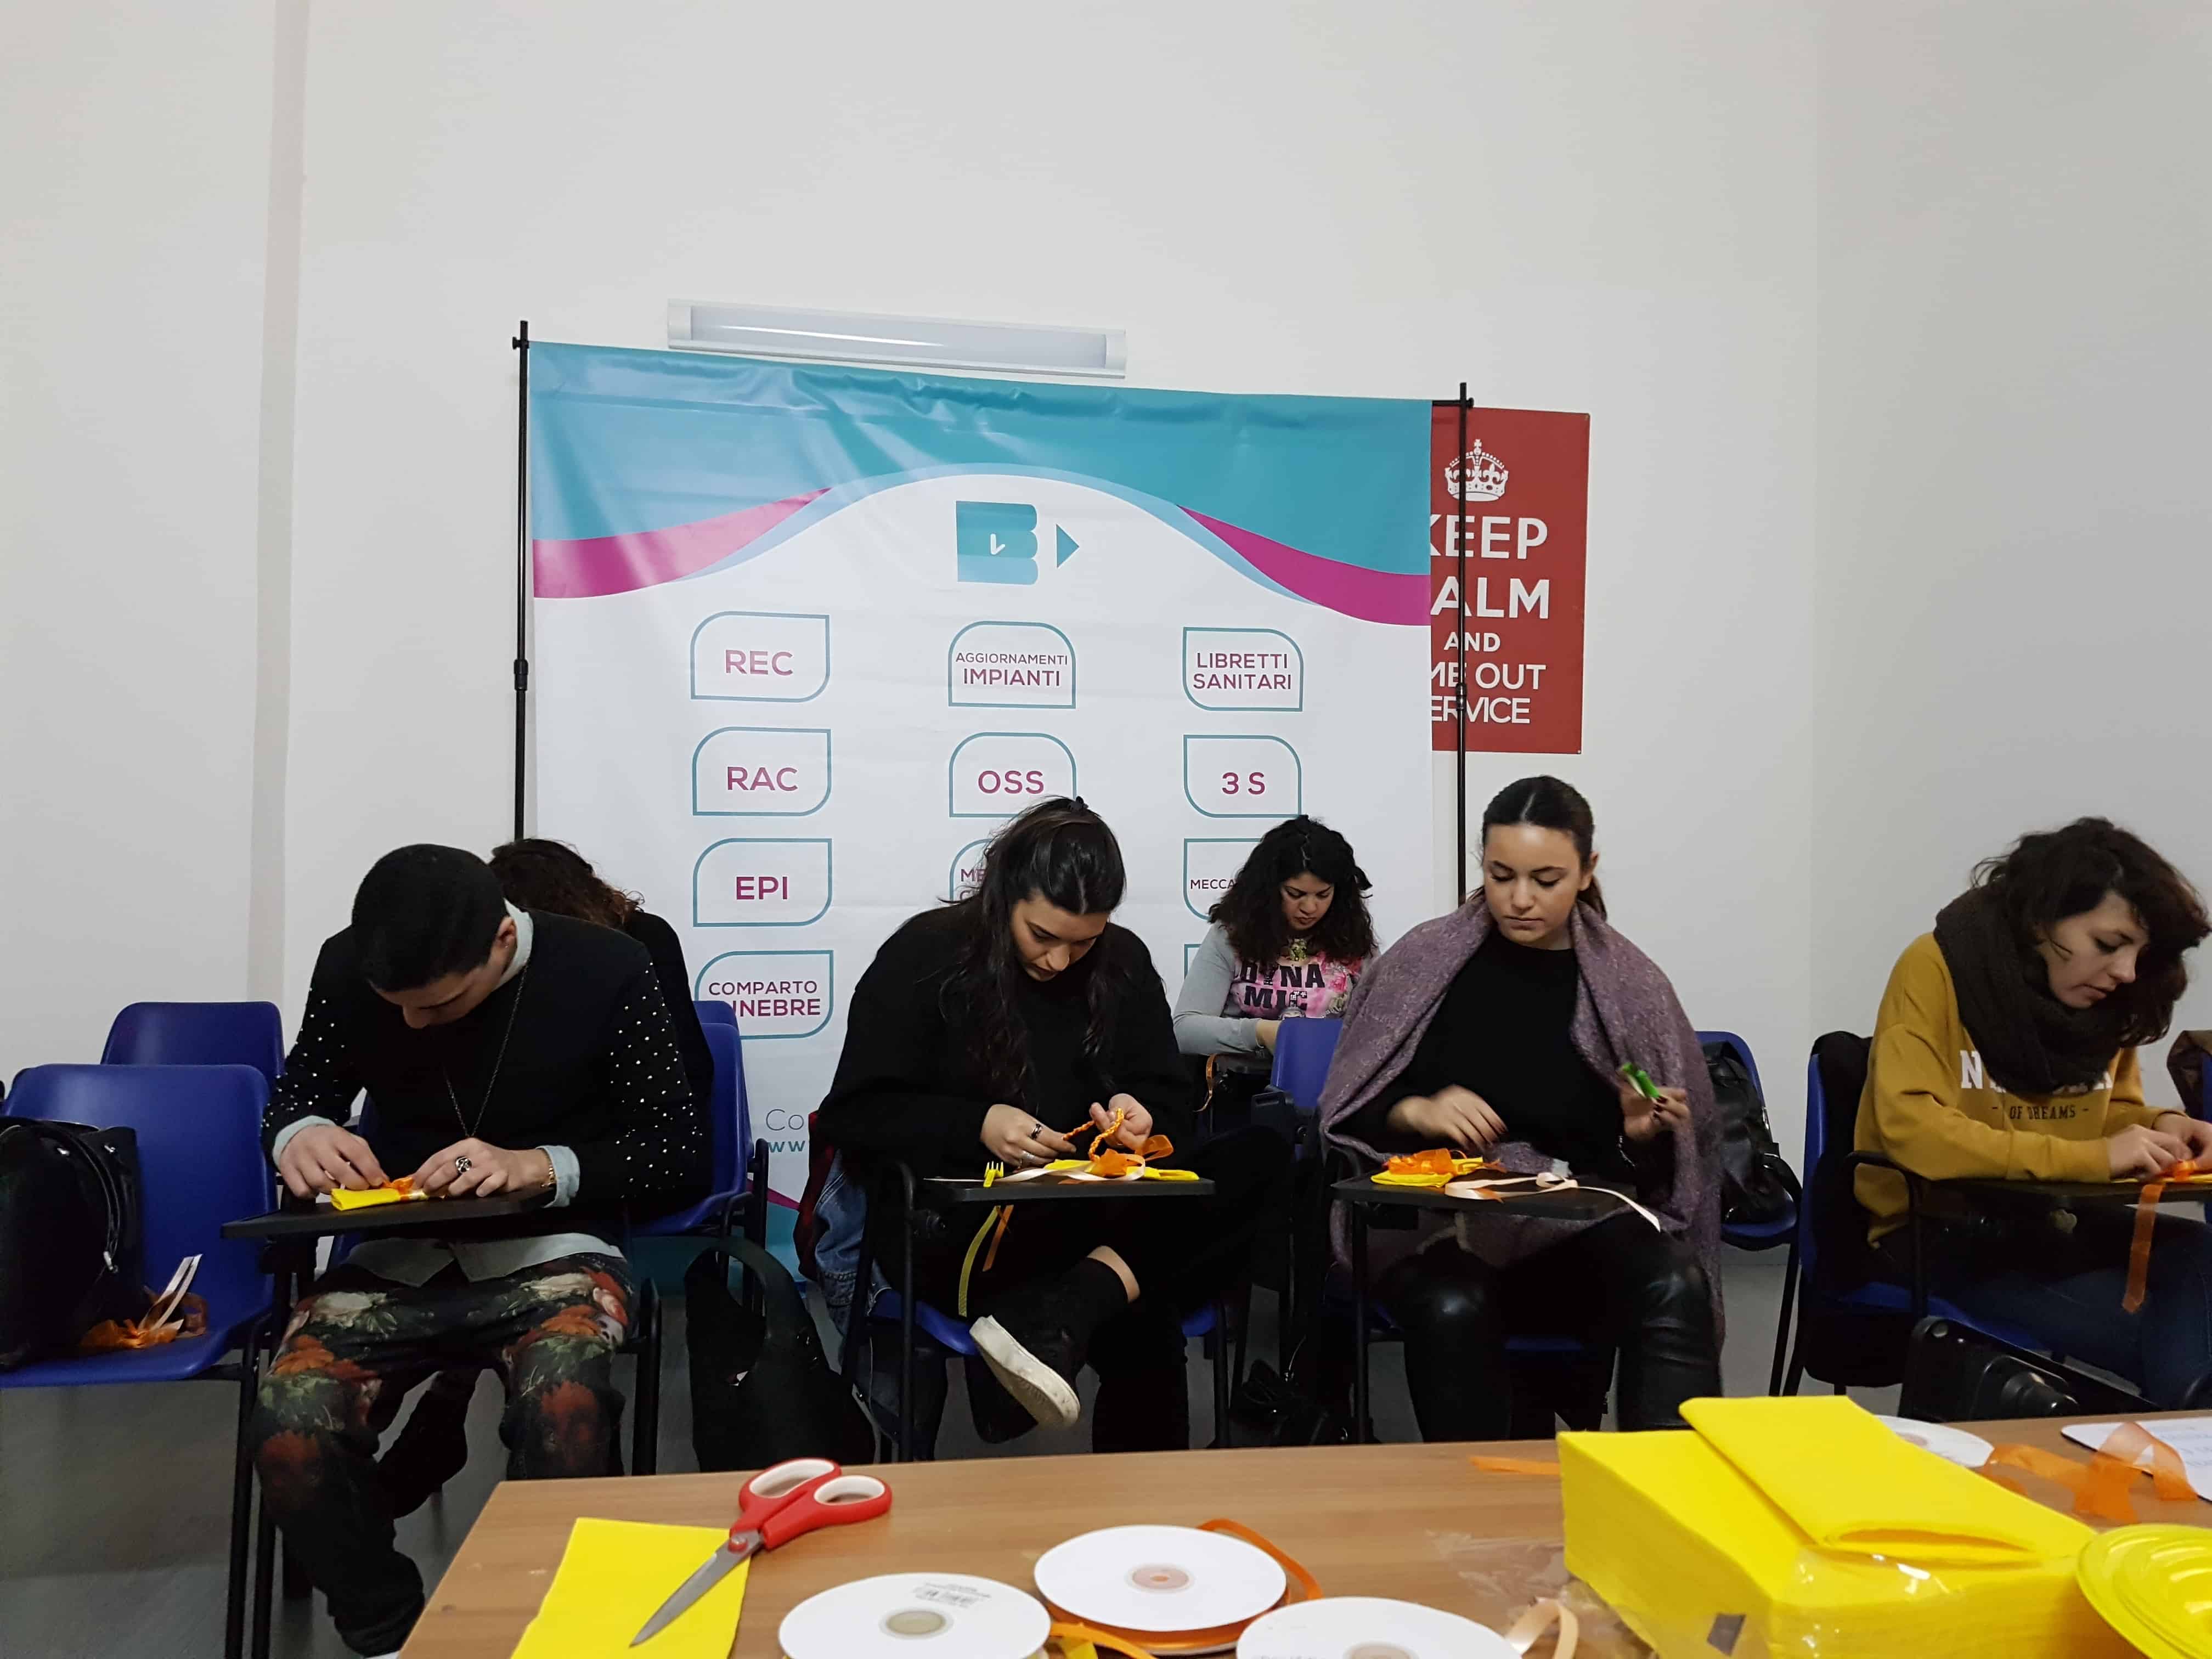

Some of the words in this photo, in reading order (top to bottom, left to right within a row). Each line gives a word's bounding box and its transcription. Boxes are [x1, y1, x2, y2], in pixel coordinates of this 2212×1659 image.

[1430, 576, 1550, 619] ALM
[1443, 631, 1501, 652] AND
[725, 649, 793, 676] REC
[955, 653, 1068, 665] AGGIORNAMENTI
[1197, 652, 1288, 669] LIBRETTI
[963, 668, 1060, 686] IMPIANTI
[1193, 673, 1291, 690] SANITARI
[1475, 662, 1547, 690] OUT
[1431, 695, 1531, 724] ERVICE
[727, 766, 798, 791] RAC
[978, 770, 1045, 794] OSS
[736, 876, 788, 900] EPI
[709, 980, 817, 996] COMPARTO
[732, 998, 821, 1017] NEBRE
[2010, 1106, 2023, 1120] OF
[2028, 1105, 2076, 1120] DREAMS
